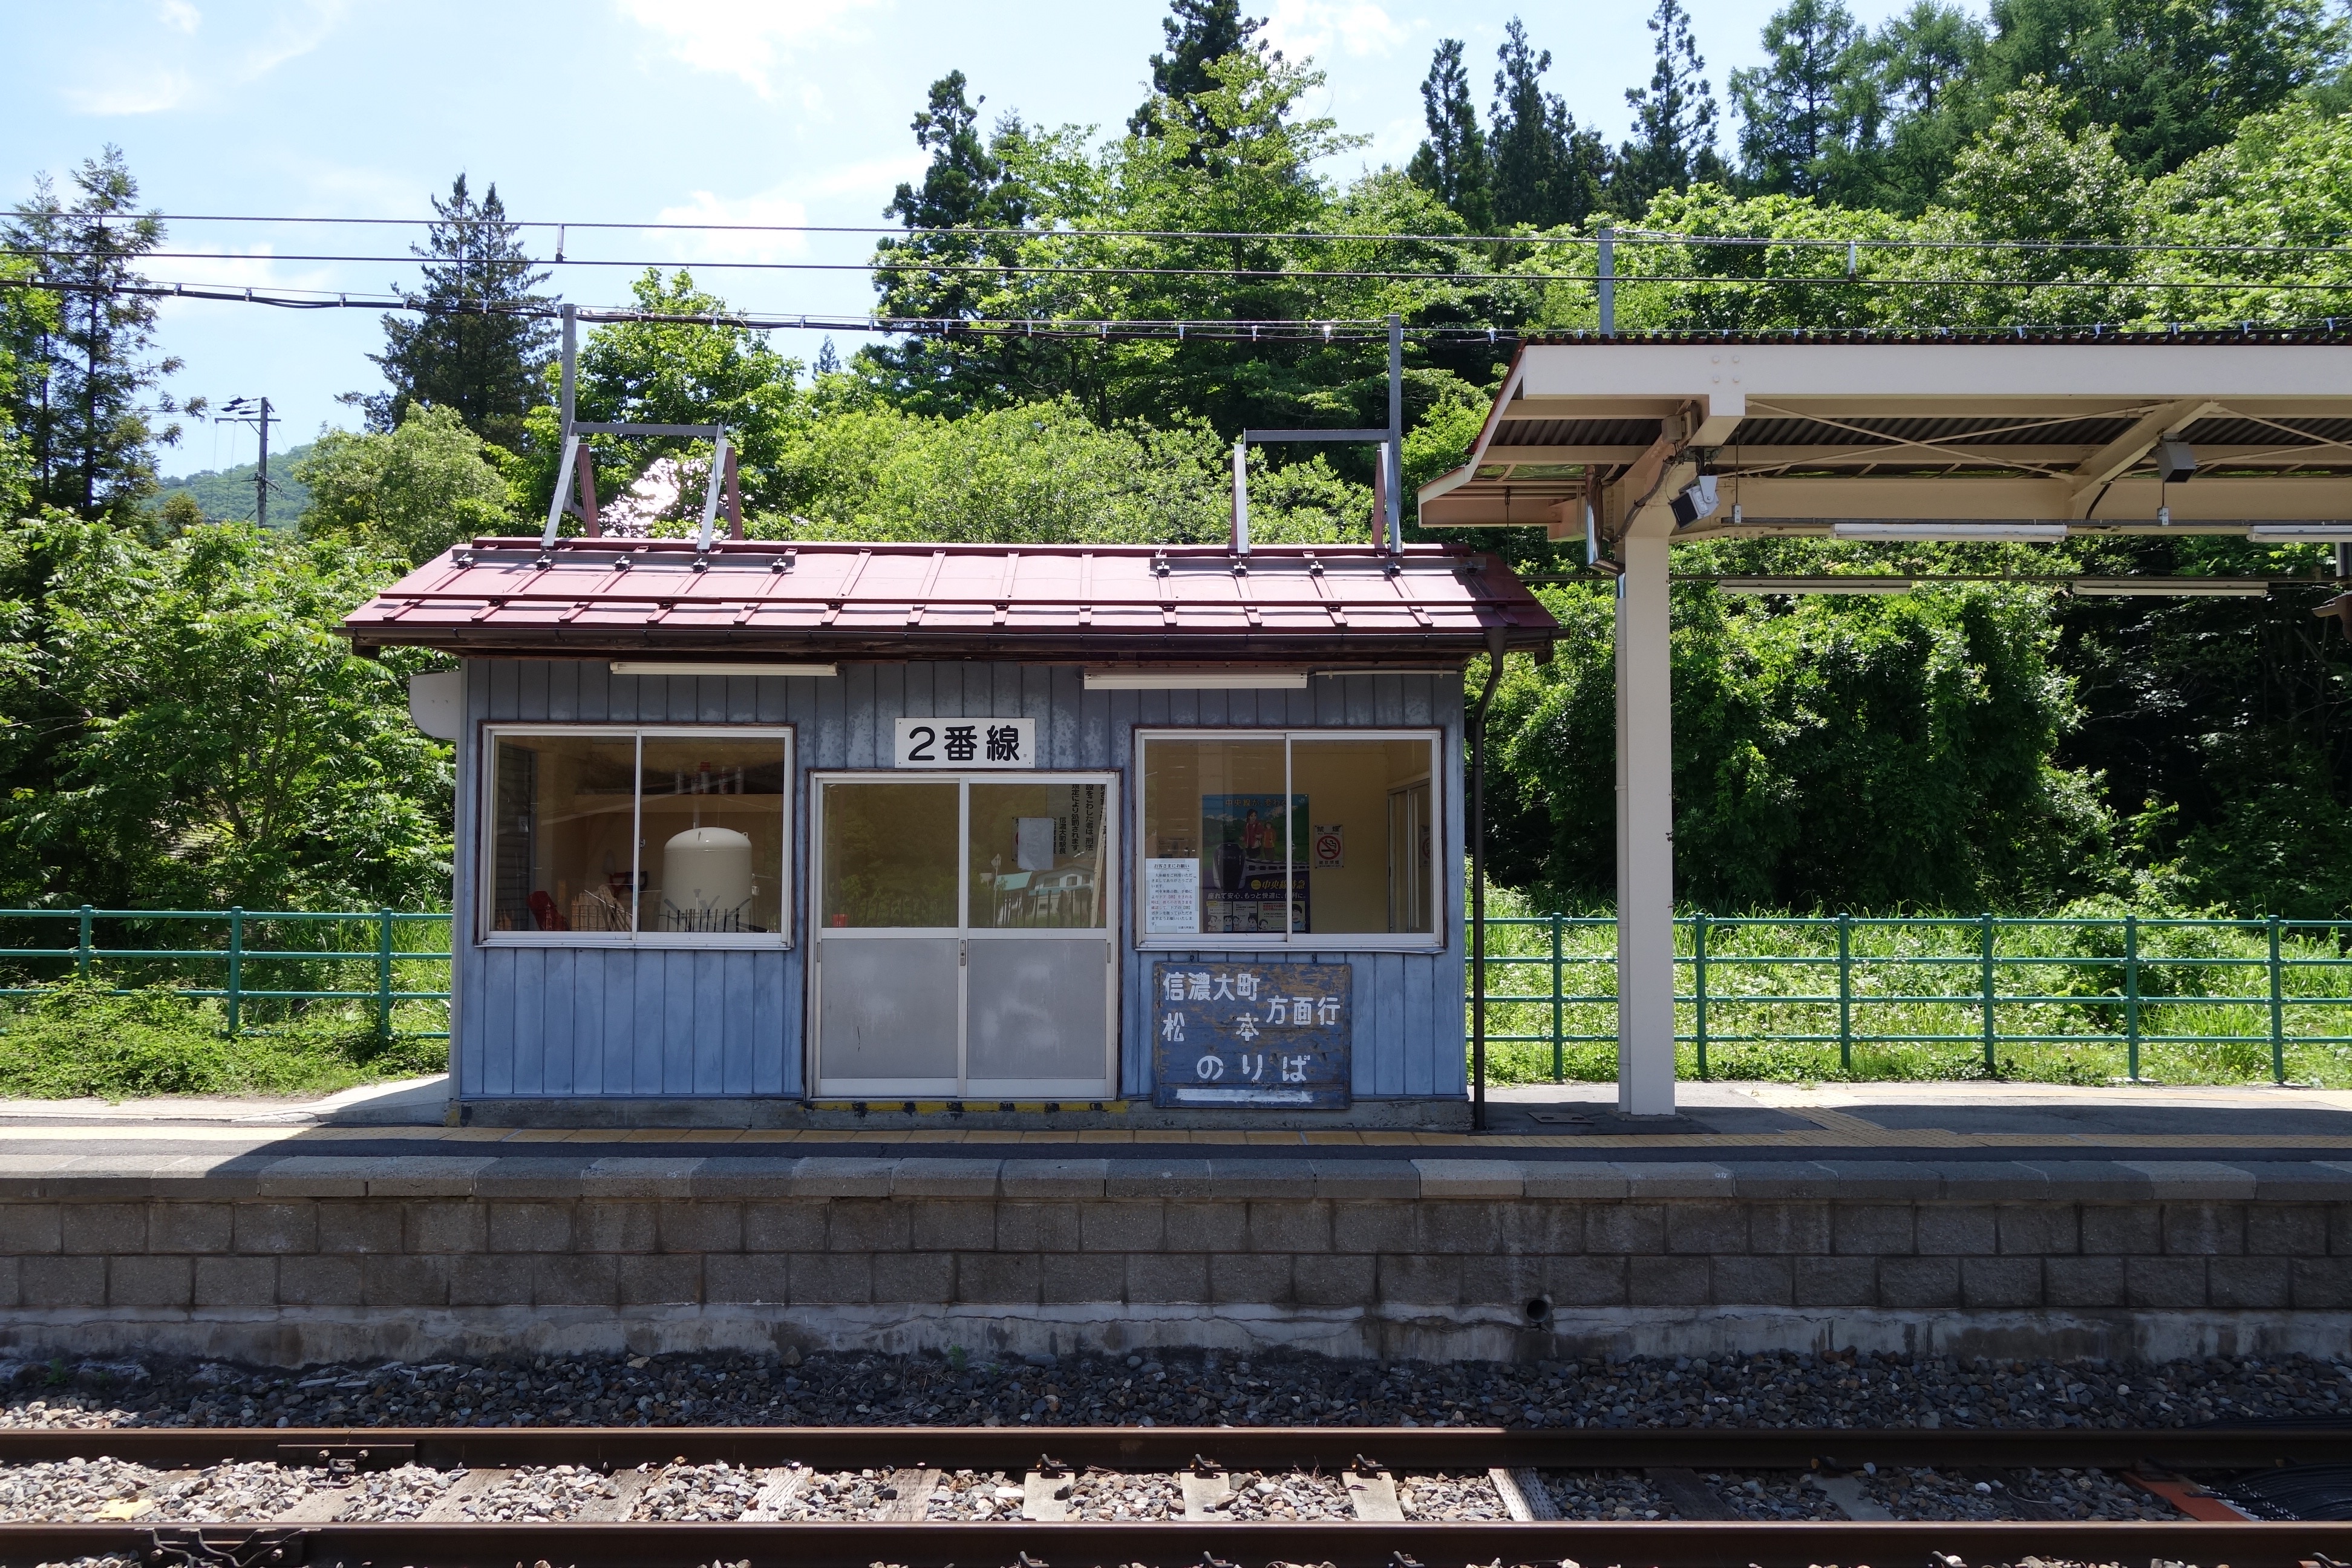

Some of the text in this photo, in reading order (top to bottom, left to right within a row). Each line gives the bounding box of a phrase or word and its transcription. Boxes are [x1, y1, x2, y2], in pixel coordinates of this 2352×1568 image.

[908, 725, 1020, 762] 2番線
[1162, 972, 1260, 1002] 信濃大町
[1266, 995, 1341, 1026] 方面行
[1197, 1054, 1311, 1082] のりば
